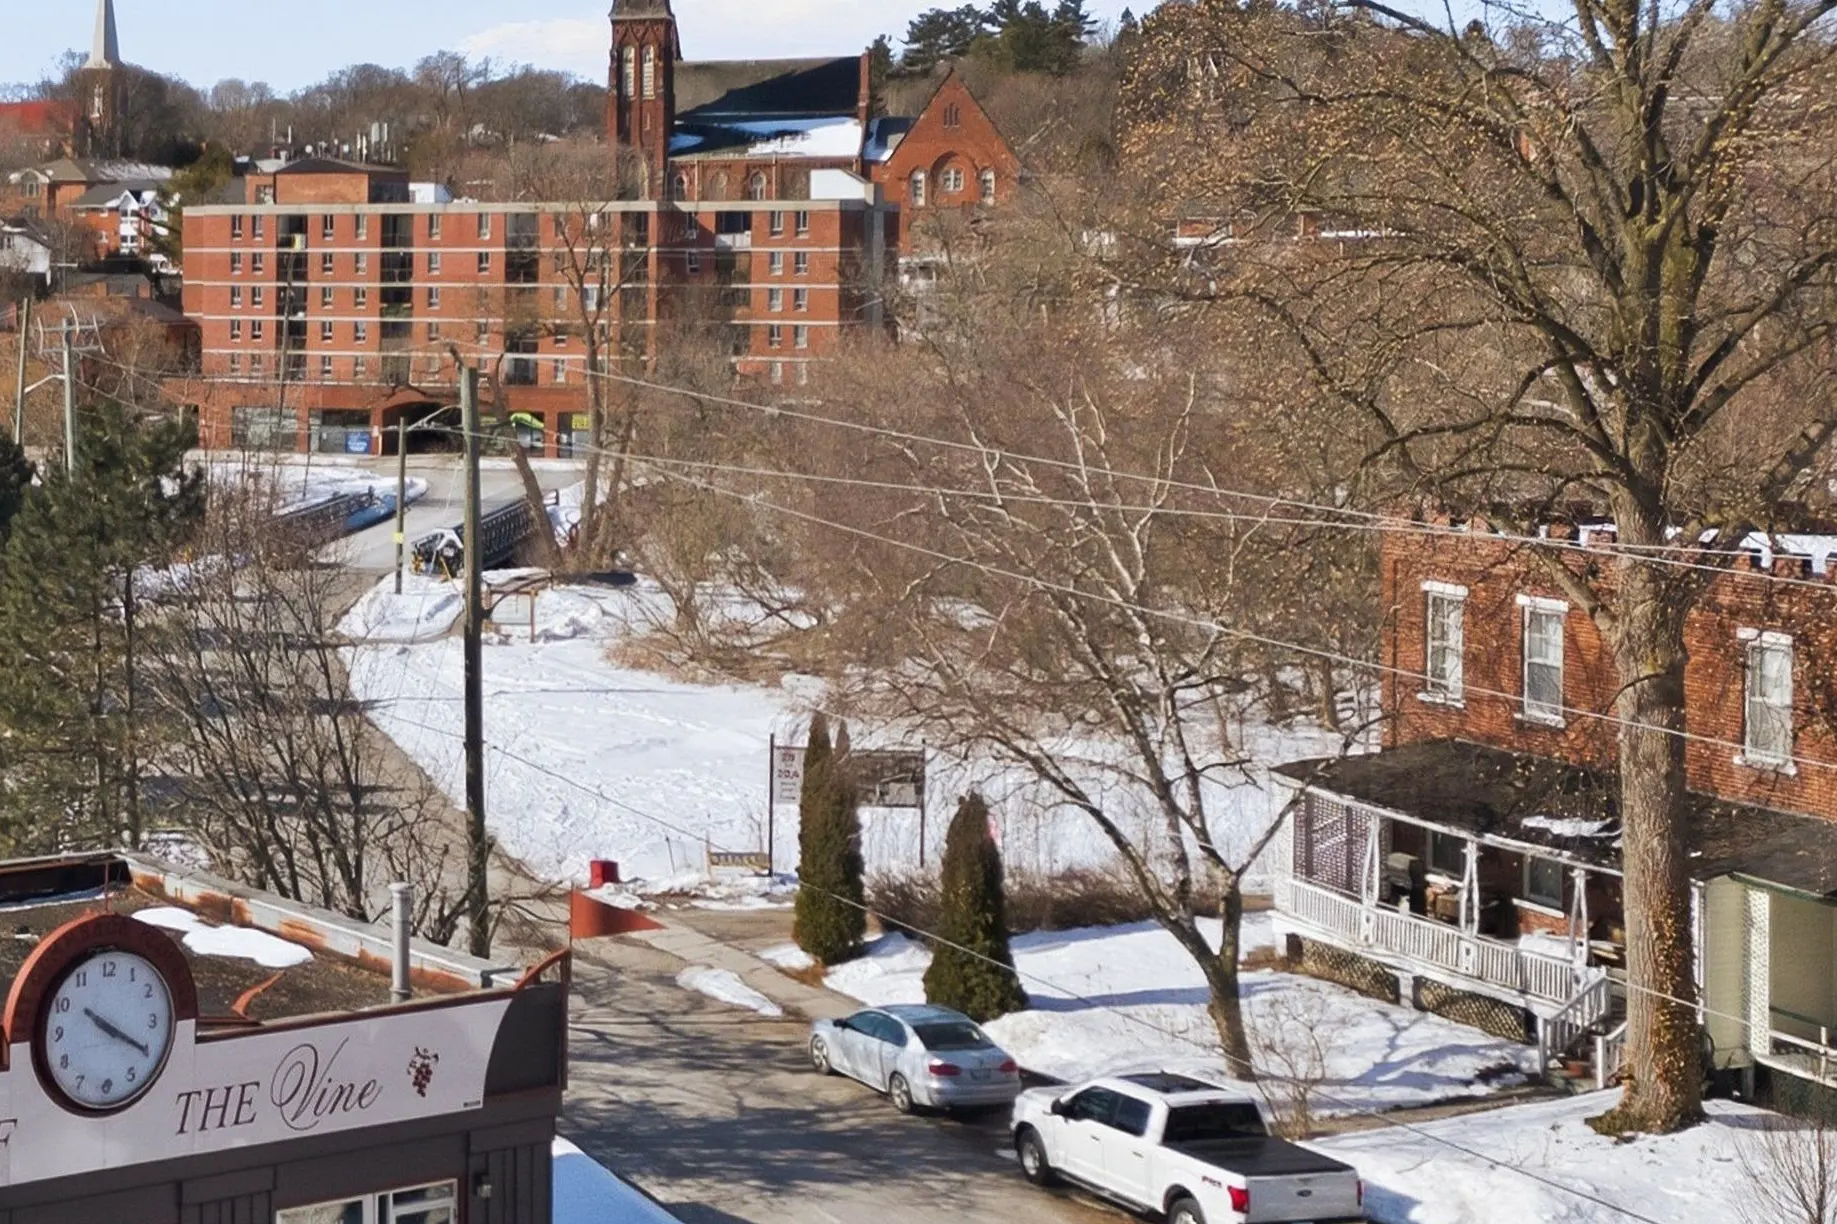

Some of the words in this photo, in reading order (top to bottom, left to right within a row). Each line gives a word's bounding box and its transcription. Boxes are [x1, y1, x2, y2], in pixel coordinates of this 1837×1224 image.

[102, 961, 116, 977] 12
[130, 967, 136, 982] 1
[76, 971, 87, 988] 11
[144, 983, 153, 999] 2
[55, 997, 70, 1014] 10
[148, 1013, 157, 1029] 3
[54, 1026, 64, 1042] 9
[60, 1053, 69, 1069] 8
[76, 1074, 85, 1090] 7
[126, 1066, 136, 1082] 5
[175, 1081, 260, 1135] THE
[270, 1035, 383, 1130] Vine
